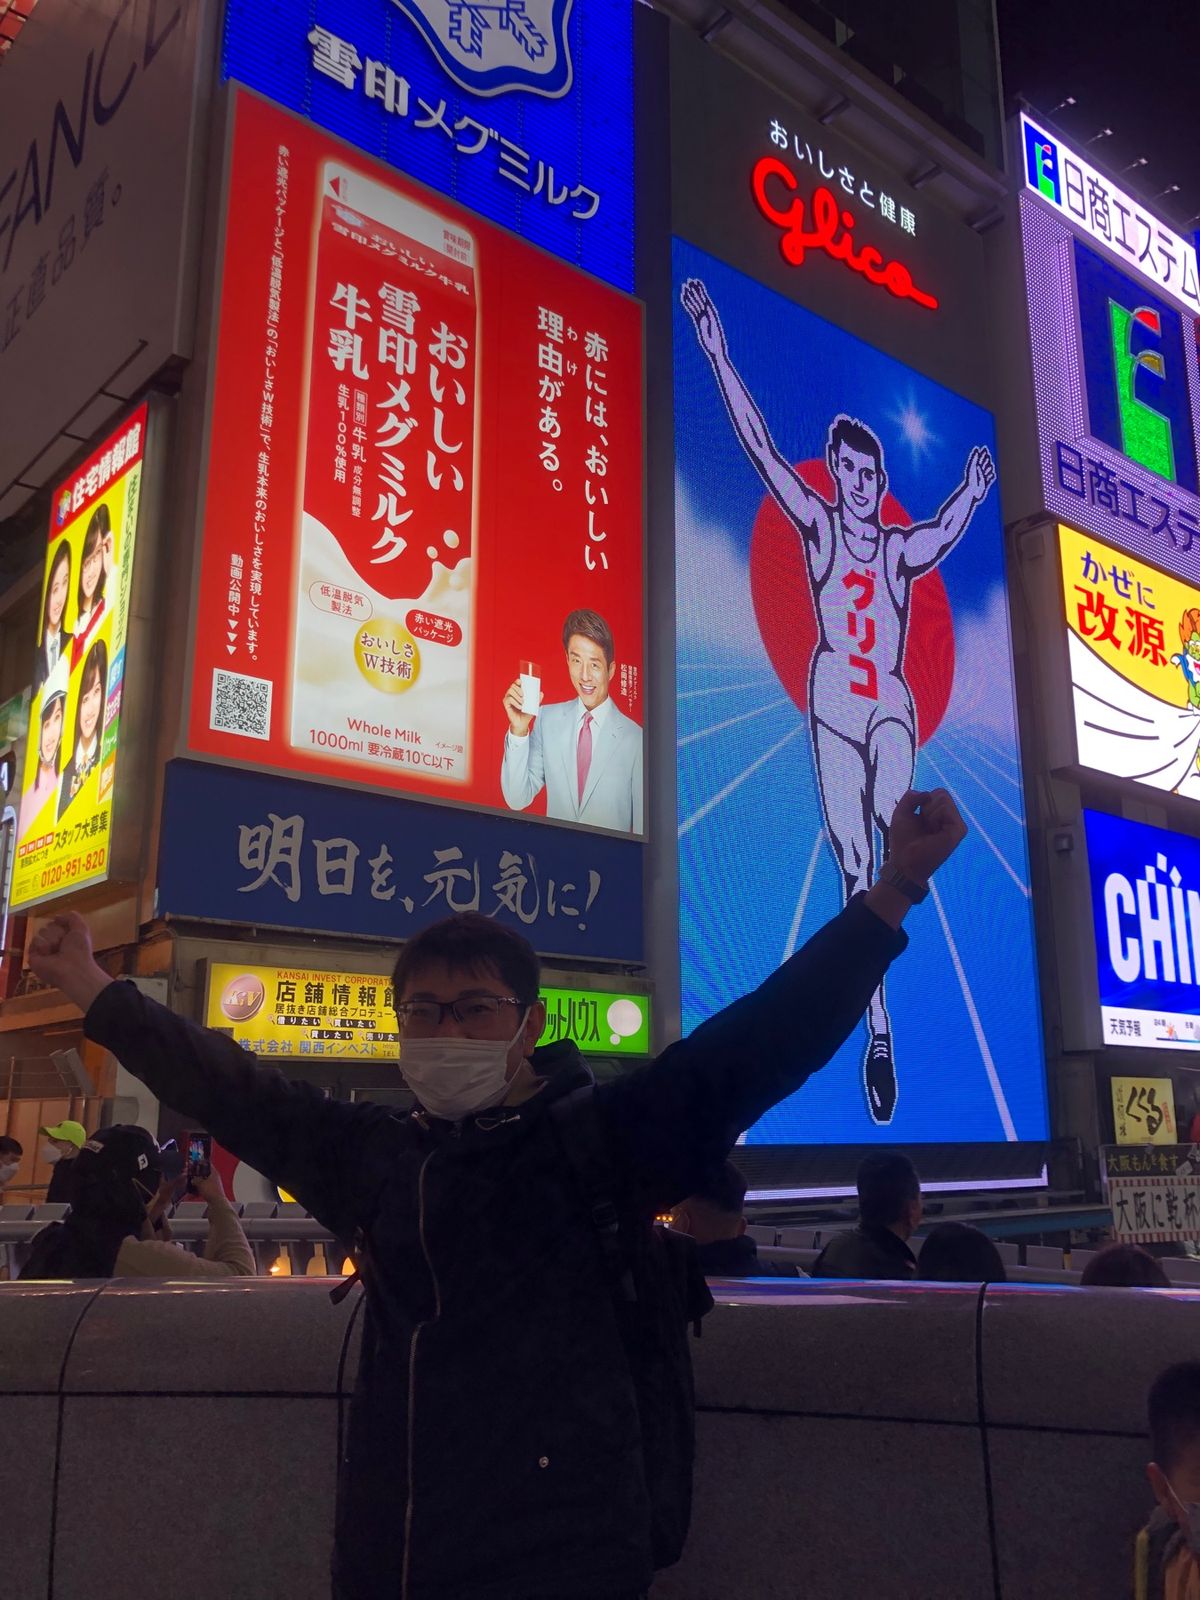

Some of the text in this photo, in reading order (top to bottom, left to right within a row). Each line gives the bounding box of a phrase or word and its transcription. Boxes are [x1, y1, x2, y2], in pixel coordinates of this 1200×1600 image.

[307, 23, 601, 221] 雪印メグミルク
[769, 119, 916, 237] おいしさと健康
[752, 156, 939, 310] Glico
[328, 282, 373, 381] 牛乳
[370, 281, 422, 565] 雪印メグミルク
[427, 321, 469, 492] おいしい
[537, 305, 566, 492] 理由がある。
[333, 383, 350, 484] 生乳100%使用
[584, 330, 609, 571] 赤には、おいしい
[73, 422, 141, 513] 住宅情報館
[227, 552, 244, 617] 動画公開中
[320, 584, 365, 608] 低温脱気
[330, 599, 353, 617] 製法
[1080, 550, 1156, 610] かぜに
[361, 632, 415, 658] おいしさ
[413, 626, 454, 643] パッケージ
[414, 613, 454, 633] 赤い遮光
[842, 569, 879, 701] グリコ
[1074, 584, 1168, 668] 改源
[364, 653, 413, 680] W技術
[309, 729, 364, 753] 1000ml
[347, 717, 422, 745] Whole Milk
[54, 810, 108, 851] スタッフ大募集
[40, 847, 106, 889] 0120-951-820
[277, 970, 310, 981] KANSAI
[312, 973, 341, 983] INVEST
[299, 1041, 378, 1056] 関西インベスト
[1110, 1018, 1142, 1037] 天気予報
